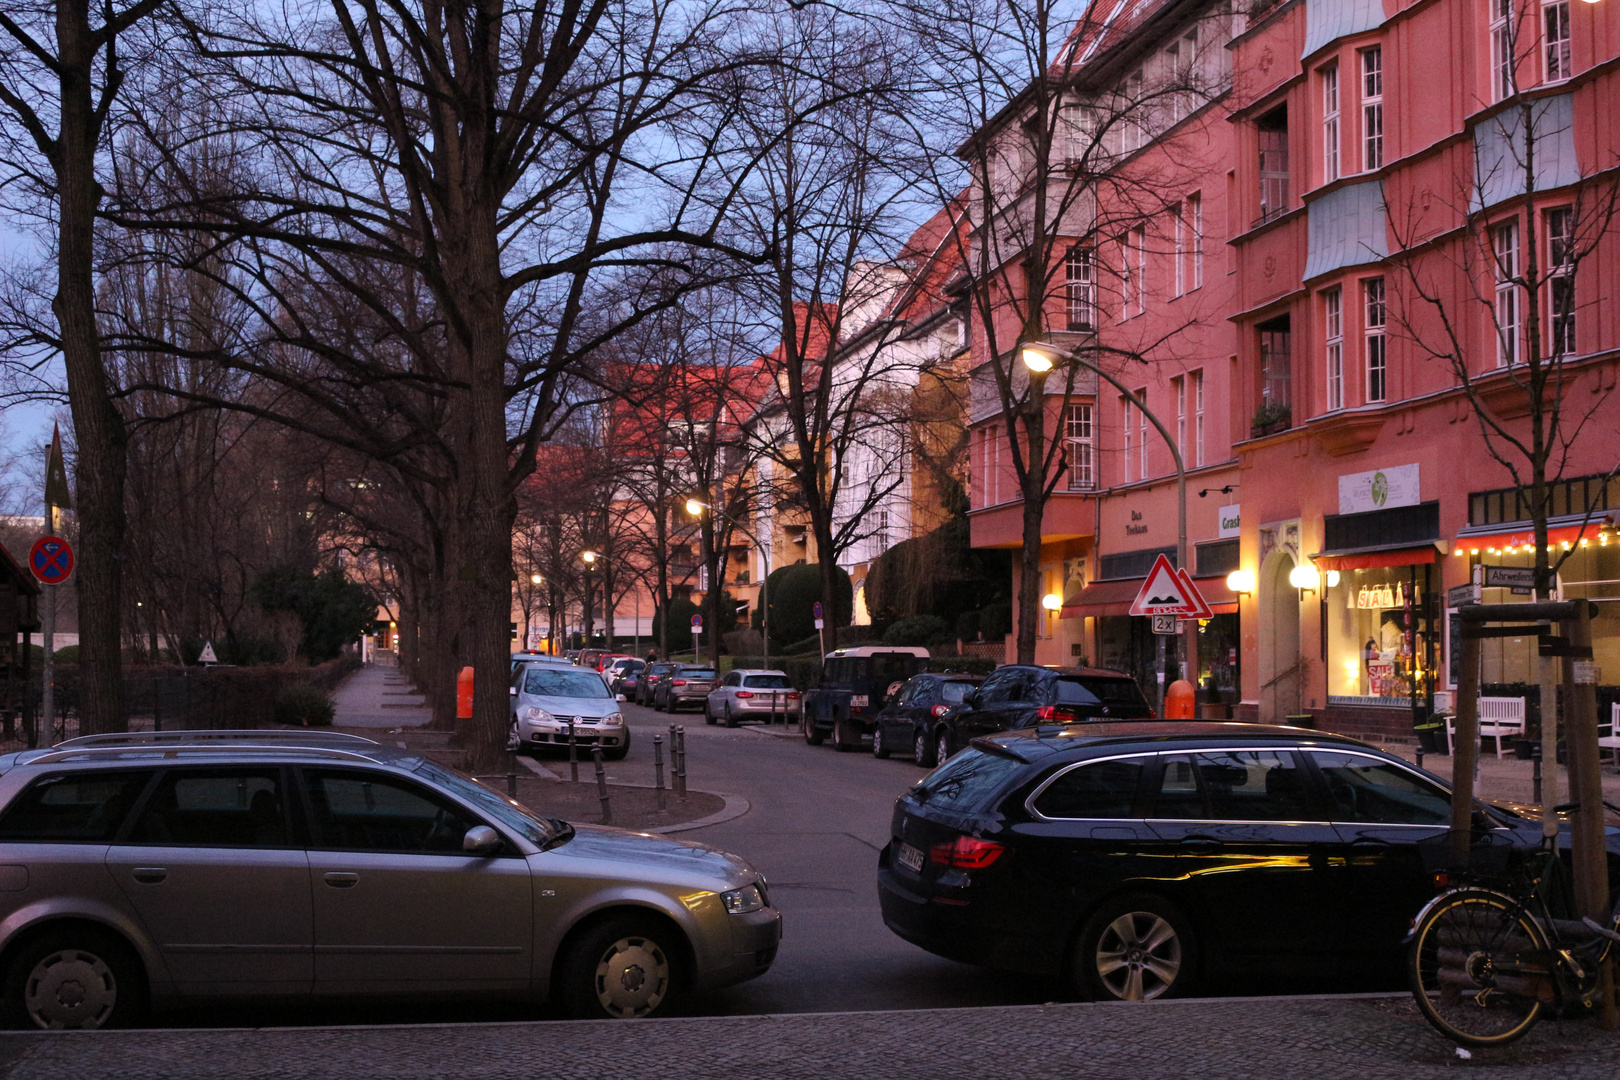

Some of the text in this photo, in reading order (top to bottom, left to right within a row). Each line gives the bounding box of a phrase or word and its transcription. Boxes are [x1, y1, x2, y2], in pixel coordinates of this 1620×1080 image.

[1131, 510, 1142, 521] Das
[1492, 570, 1536, 581] Ahrweilerst
[1368, 664, 1392, 679] SALE
